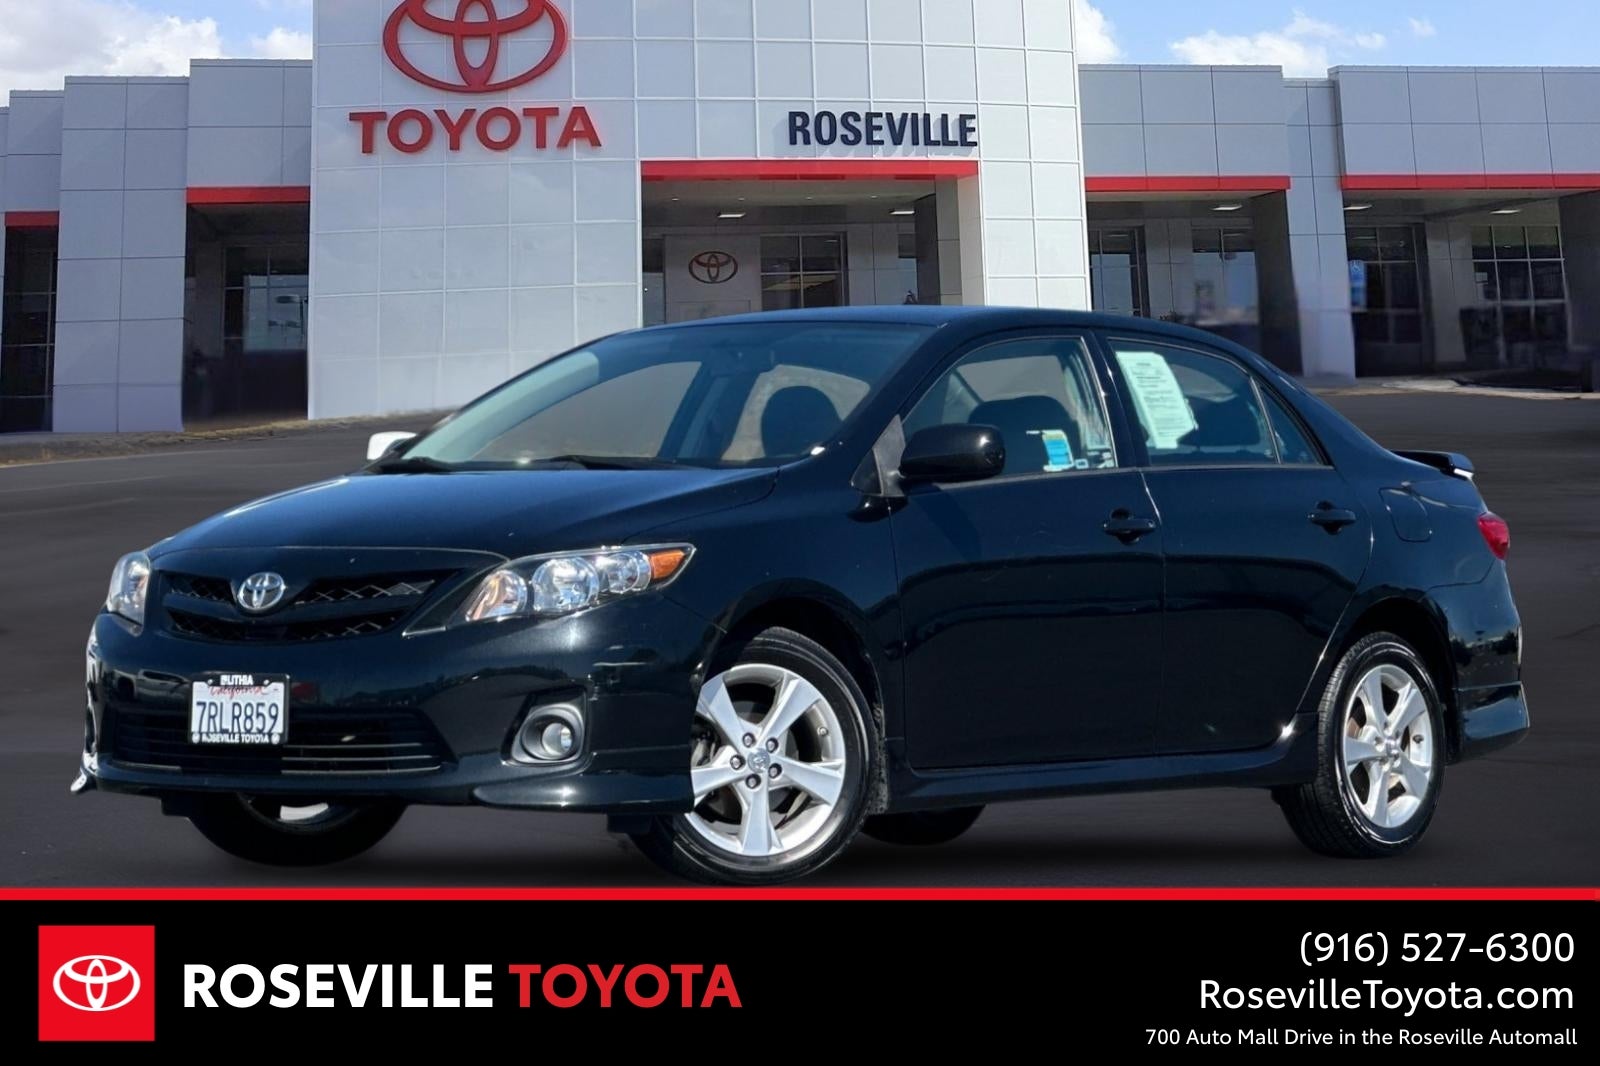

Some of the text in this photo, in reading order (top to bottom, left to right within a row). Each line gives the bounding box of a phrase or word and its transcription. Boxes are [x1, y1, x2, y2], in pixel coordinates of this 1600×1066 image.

[349, 106, 602, 154] TOYOTA
[788, 110, 978, 148] ROSEVILLE
[196, 701, 279, 734] 7RLR859
